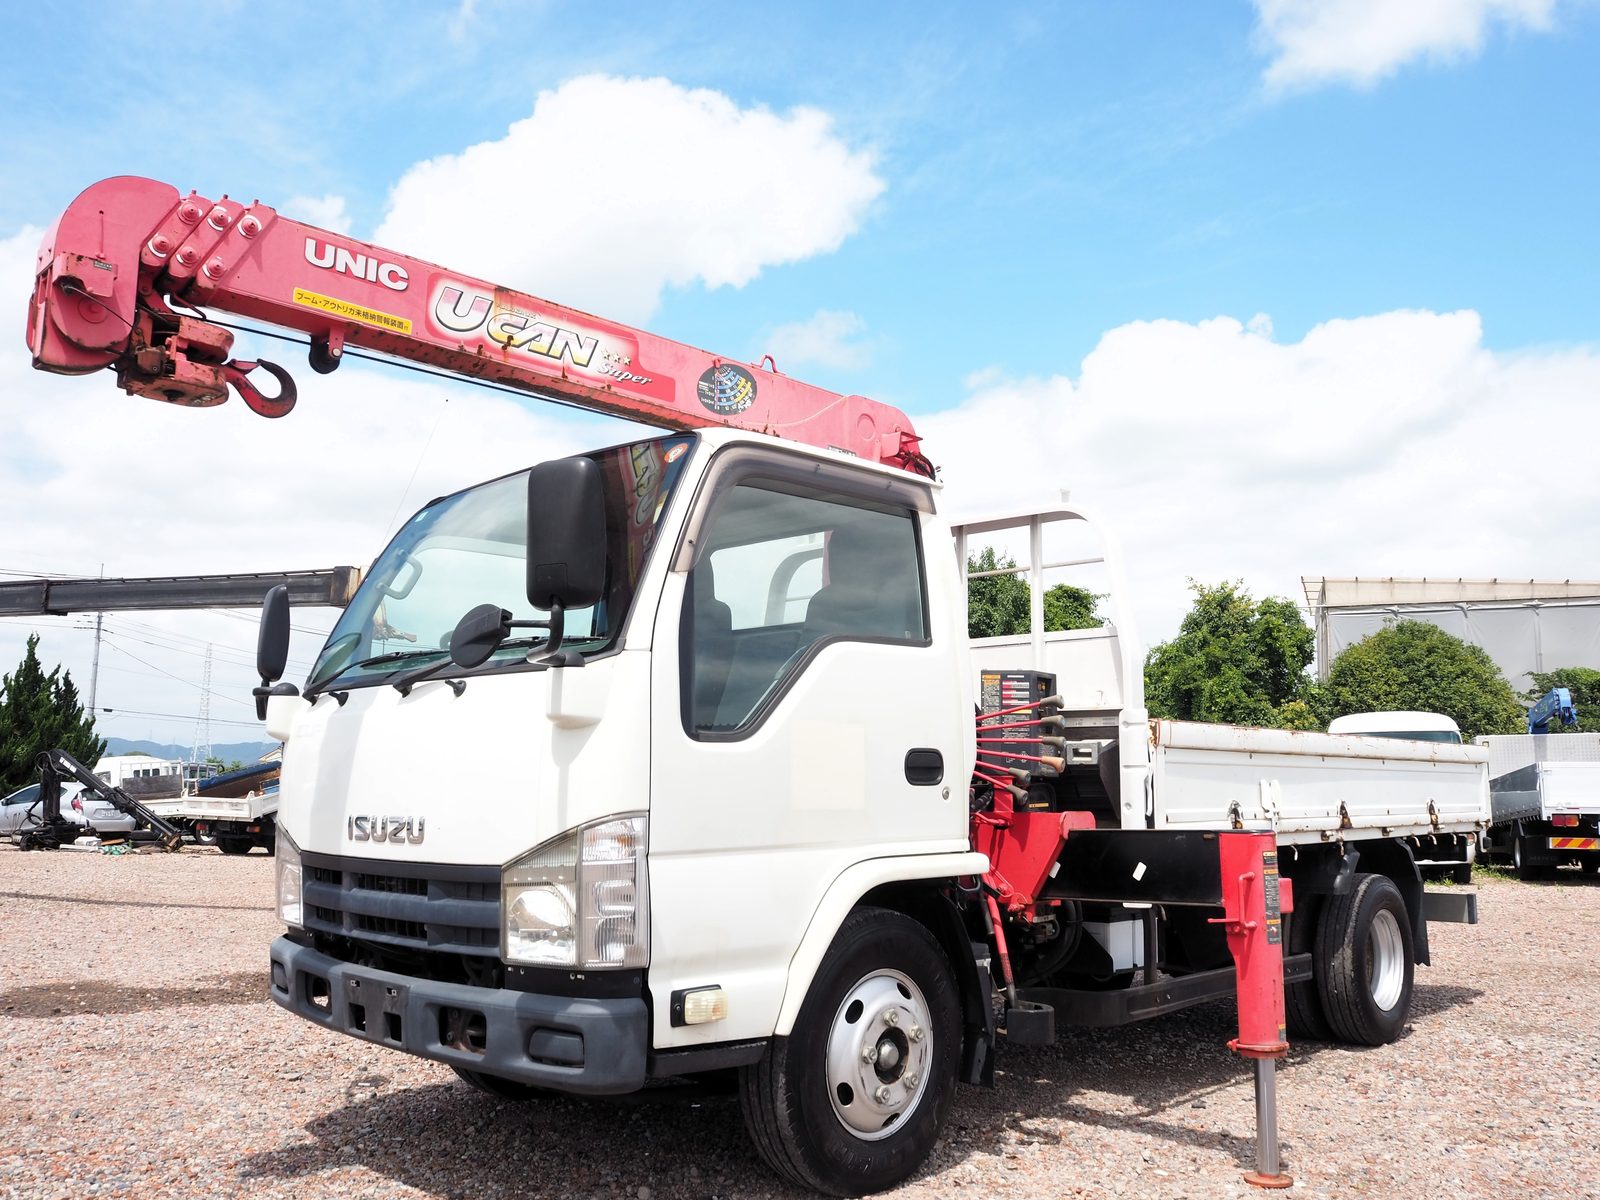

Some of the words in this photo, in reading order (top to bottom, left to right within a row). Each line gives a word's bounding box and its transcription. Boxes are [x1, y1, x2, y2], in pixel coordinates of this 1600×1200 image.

[304, 237, 409, 291] UNIC
[435, 286, 599, 368] UCAN
[597, 362, 653, 385] Super
[347, 815, 425, 844] ISUZU
